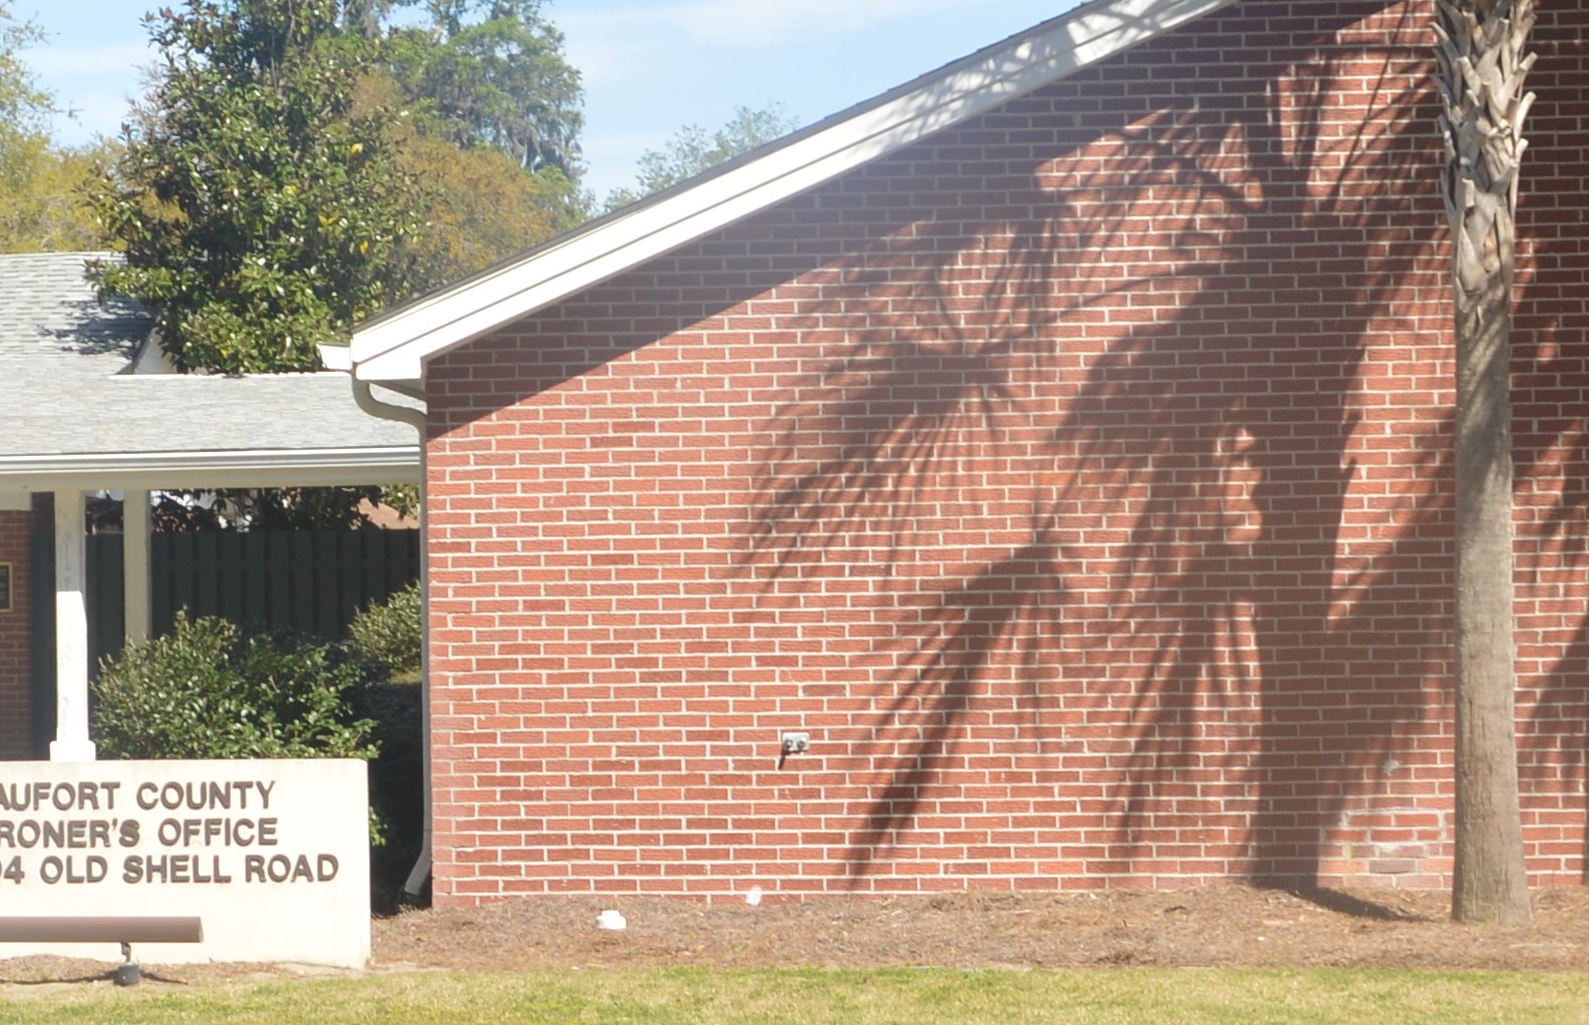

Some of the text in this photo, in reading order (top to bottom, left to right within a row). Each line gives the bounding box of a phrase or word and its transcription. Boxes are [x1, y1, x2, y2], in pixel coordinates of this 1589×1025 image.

[136, 780, 276, 811] COUNTY
[157, 817, 278, 848] OFFICE
[39, 855, 108, 885] OLD
[122, 854, 232, 885] SHELL
[244, 853, 339, 884] ROAD
